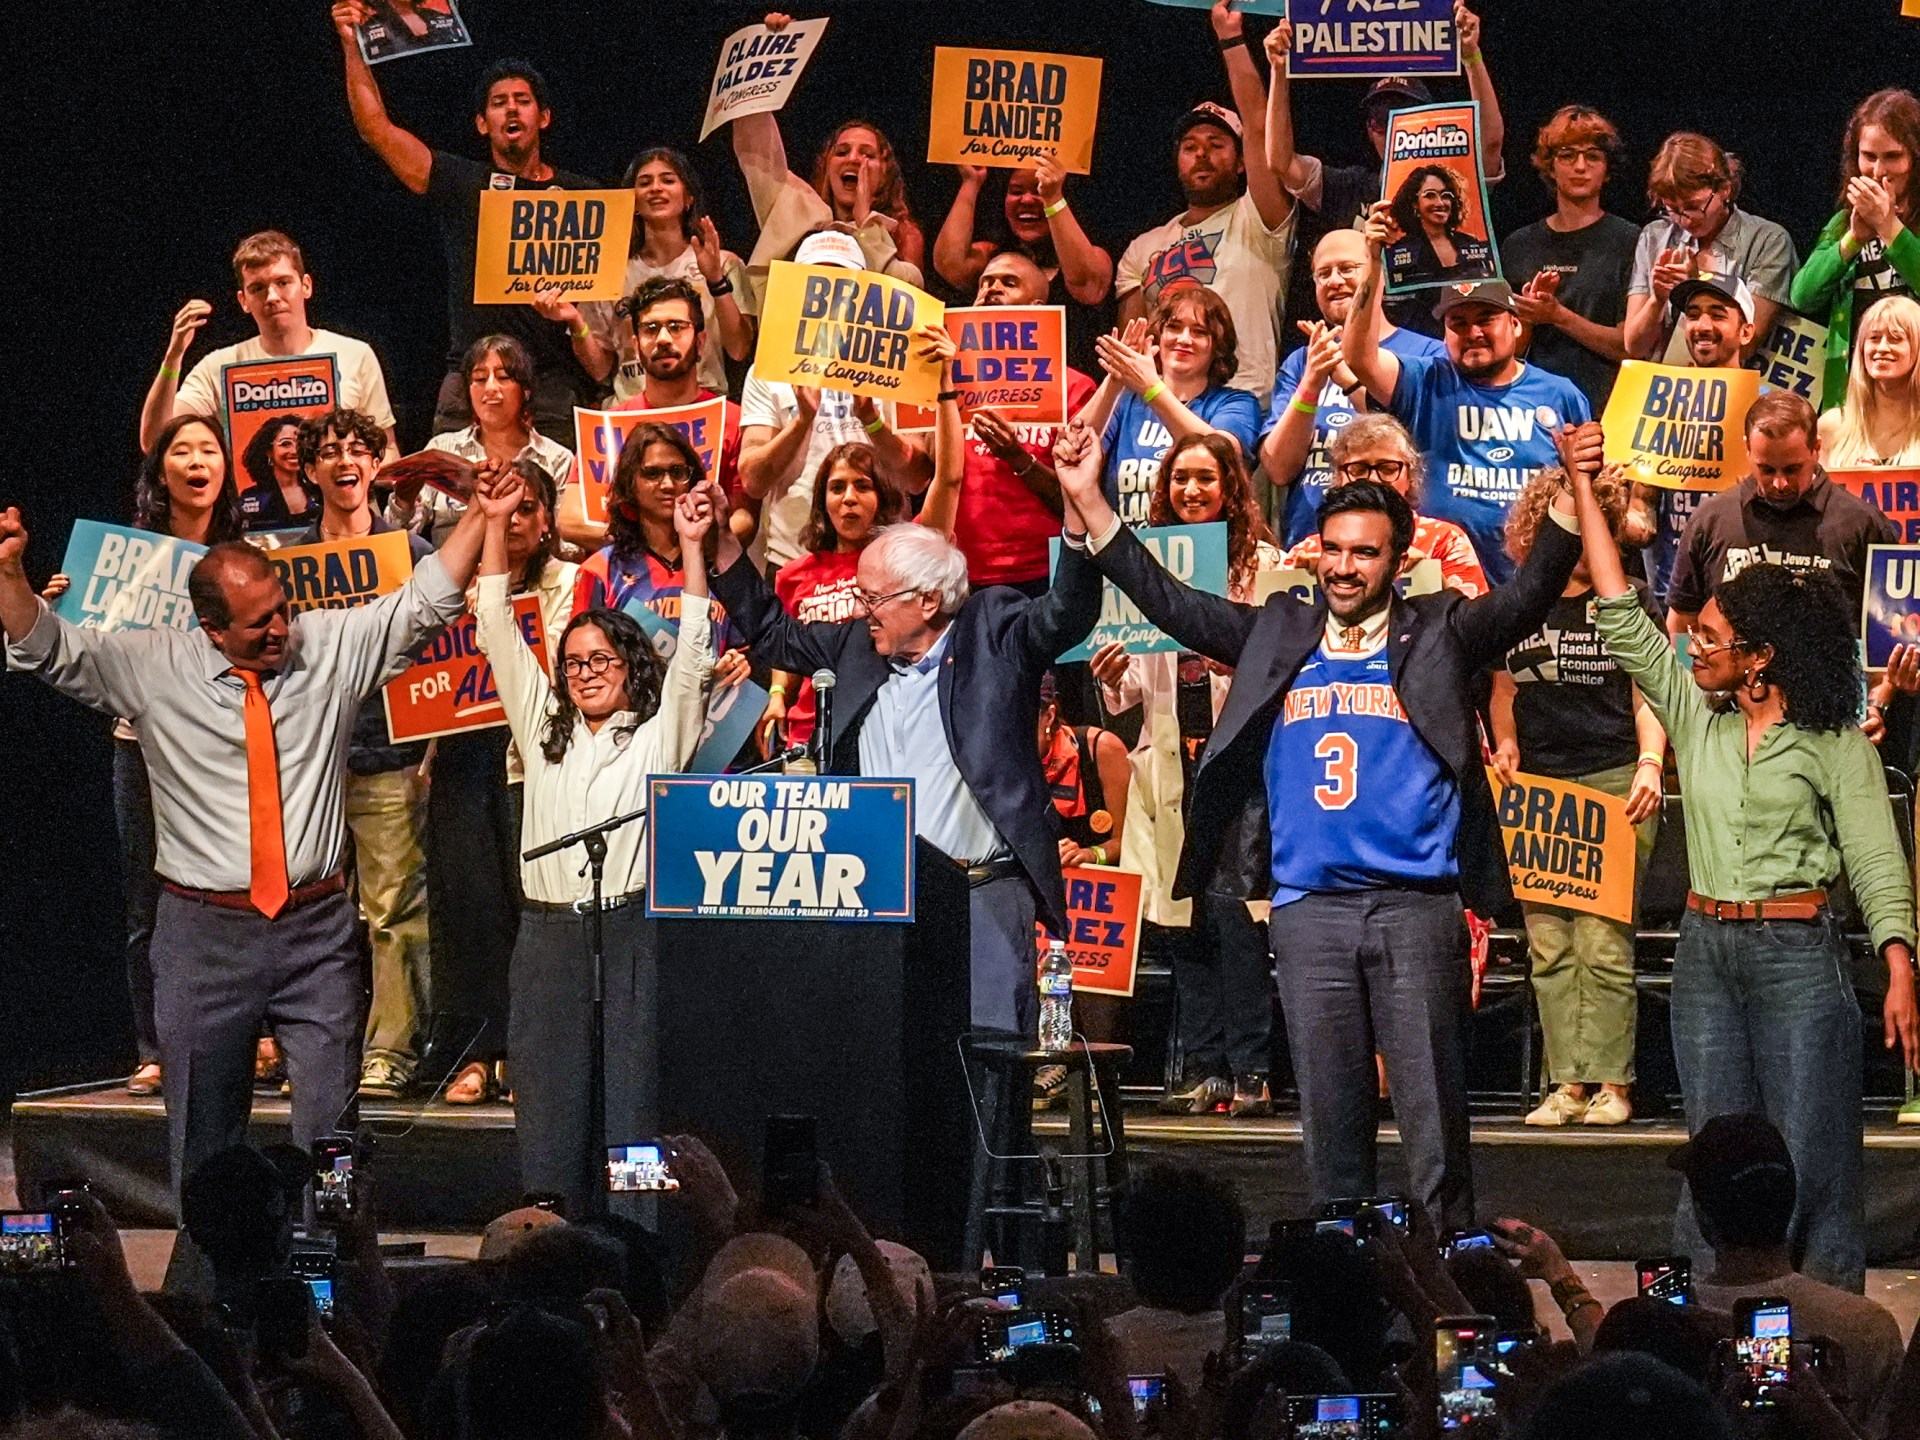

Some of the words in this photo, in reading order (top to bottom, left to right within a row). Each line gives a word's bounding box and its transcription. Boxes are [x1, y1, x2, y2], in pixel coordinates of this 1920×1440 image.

[726, 33, 805, 68] CLAIRE
[1296, 20, 1451, 54] PALESTINE
[717, 58, 799, 96] VALDEZ
[966, 58, 1067, 105] BRAD
[724, 81, 781, 111] CONGRESS
[963, 102, 1063, 142] LANDER
[960, 139, 990, 155] for
[992, 140, 1058, 162] Congres
[1394, 127, 1468, 152] Darializa
[1412, 148, 1468, 158] CONGRESS
[511, 200, 605, 241] BRAD
[507, 242, 600, 275] LANDER
[1144, 238, 1215, 287] ICE
[505, 277, 531, 294] for
[534, 277, 594, 293] Congress
[802, 275, 915, 332] BRAD
[794, 320, 909, 371] LANDER
[960, 321, 1038, 352] AIRE
[789, 357, 822, 375] for
[824, 361, 902, 389] Congress
[952, 357, 1053, 383] LDEZ
[233, 377, 327, 403] Darializa
[264, 397, 327, 408] CONGRESS
[1642, 375, 1727, 423] BRAD
[1137, 420, 1173, 447] UA
[1458, 405, 1534, 441] UAW
[1631, 417, 1724, 461] LANDER
[1447, 463, 1541, 490] DARIALI
[1656, 460, 1722, 483] Congress
[1452, 488, 1478, 498] FOR
[1480, 490, 1522, 500] CONG
[1782, 552, 1811, 566] Jews
[1813, 555, 1831, 569] For
[81, 576, 194, 632] LANDER
[814, 583, 836, 596] New
[1560, 644, 1597, 656] Racial
[1561, 630, 1591, 641] Jews
[409, 671, 451, 705] FOR
[453, 663, 498, 707] AL
[1561, 672, 1604, 685] Justice
[1284, 684, 1333, 726] NEW
[1331, 681, 1409, 723] YORK
[1314, 732, 1358, 811] 3
[709, 780, 767, 808] OUR
[774, 781, 850, 809] TEAM
[1499, 783, 1606, 845] BRAD
[737, 808, 828, 853] OUR
[1509, 830, 1603, 885] ANDER
[694, 851, 867, 908] YEAR
[1523, 871, 1599, 900] Congress
[697, 905, 718, 915] VOTE
[719, 906, 728, 915] IN
[729, 906, 744, 915] THE
[745, 907, 796, 916] DEMOCRATIC
[796, 907, 834, 917] PRIMARY
[834, 907, 856, 917] JUNE
[856, 908, 869, 917] 23
